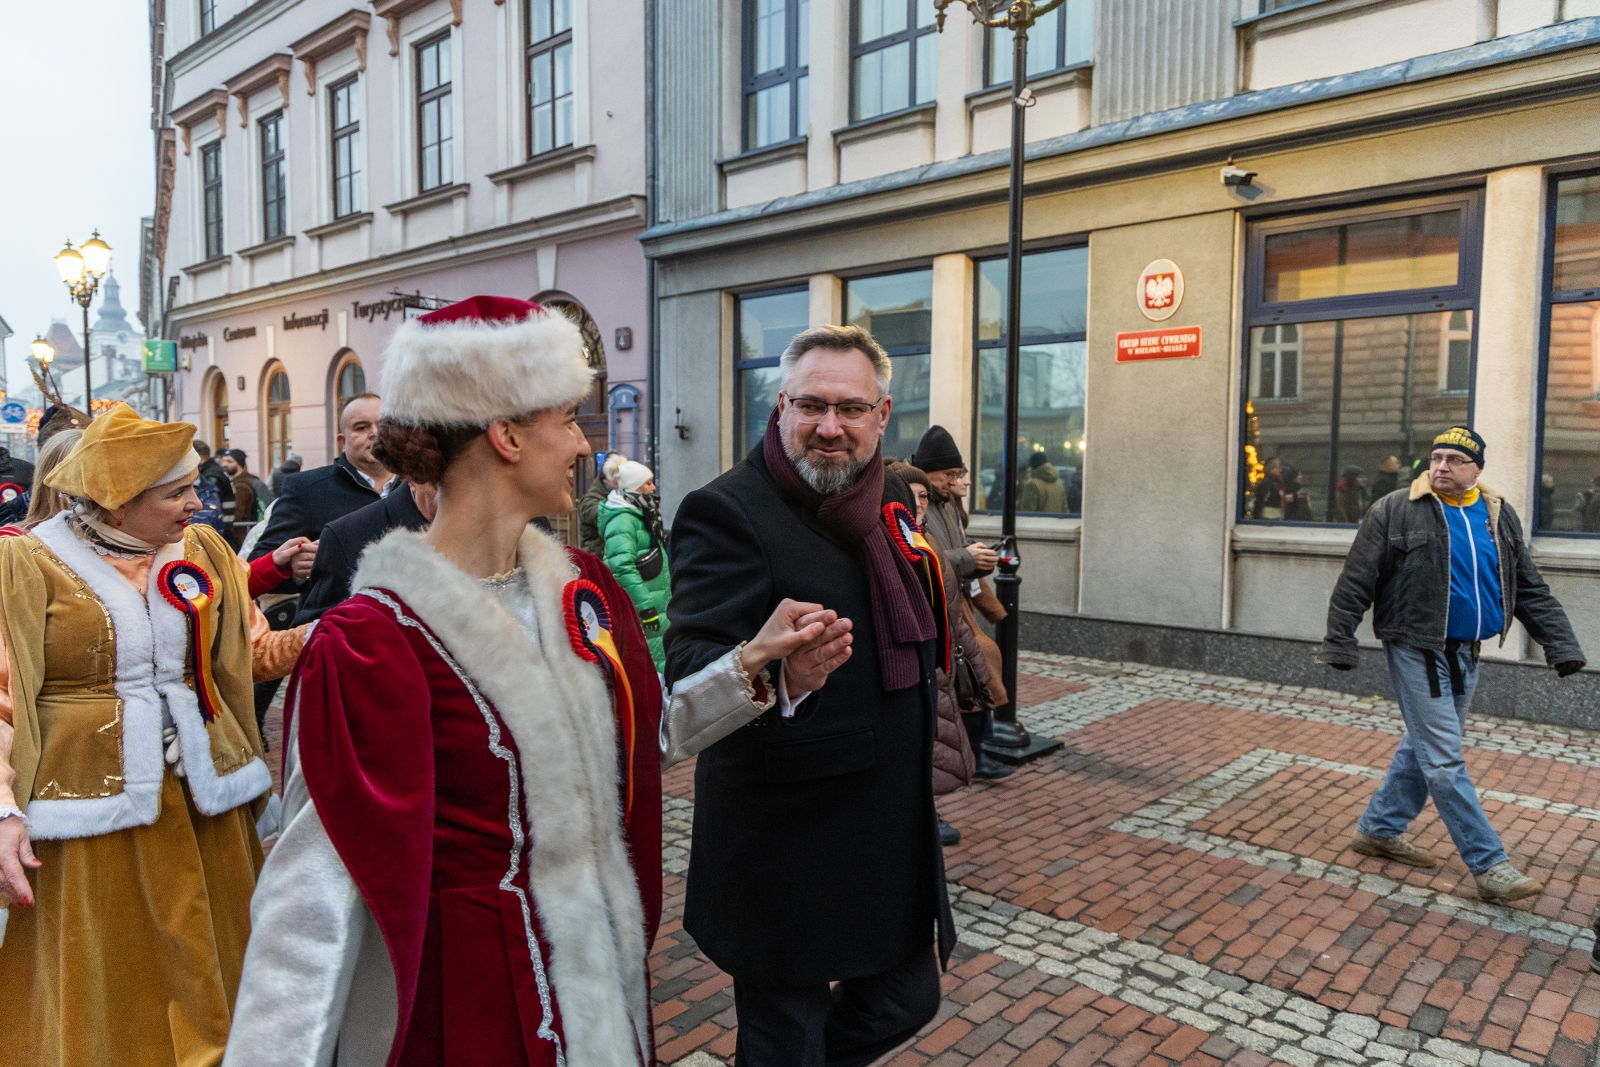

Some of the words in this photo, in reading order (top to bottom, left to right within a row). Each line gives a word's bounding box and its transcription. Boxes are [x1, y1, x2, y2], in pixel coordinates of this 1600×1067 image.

[223, 327, 256, 343] Centrum
[283, 308, 329, 331] Informacji
[1161, 333, 1197, 344] CYWILNEGO
